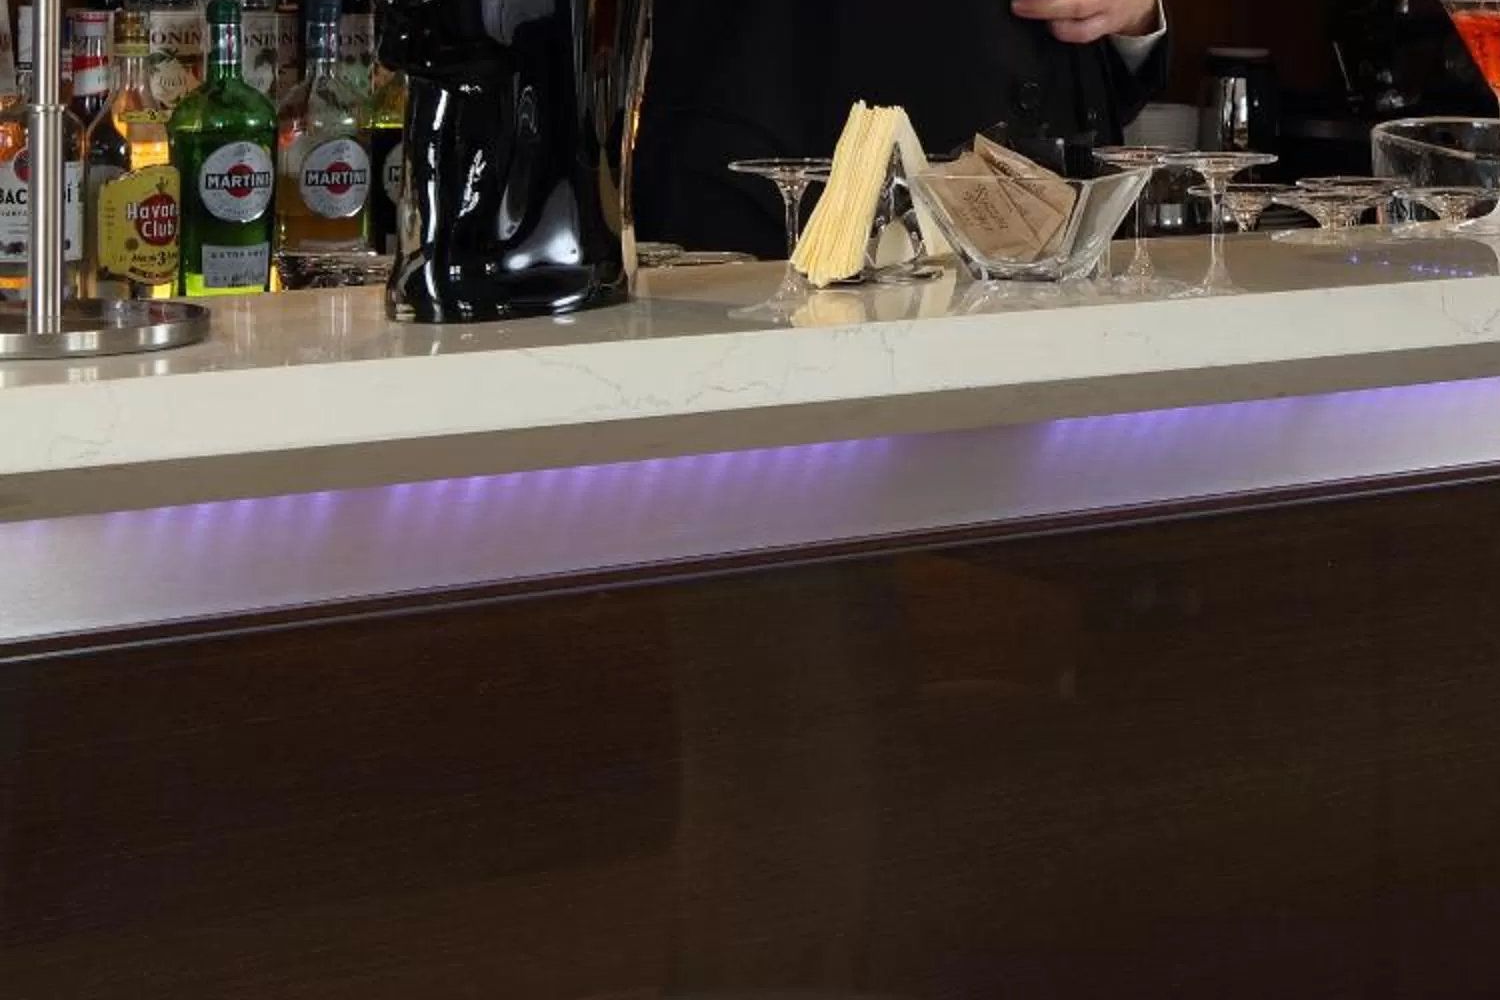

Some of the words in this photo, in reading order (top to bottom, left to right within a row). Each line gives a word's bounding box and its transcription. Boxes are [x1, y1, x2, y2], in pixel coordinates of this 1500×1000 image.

[151, 31, 202, 45] ONIN
[206, 172, 271, 190] MARTINI
[305, 169, 367, 187] MARTINI
